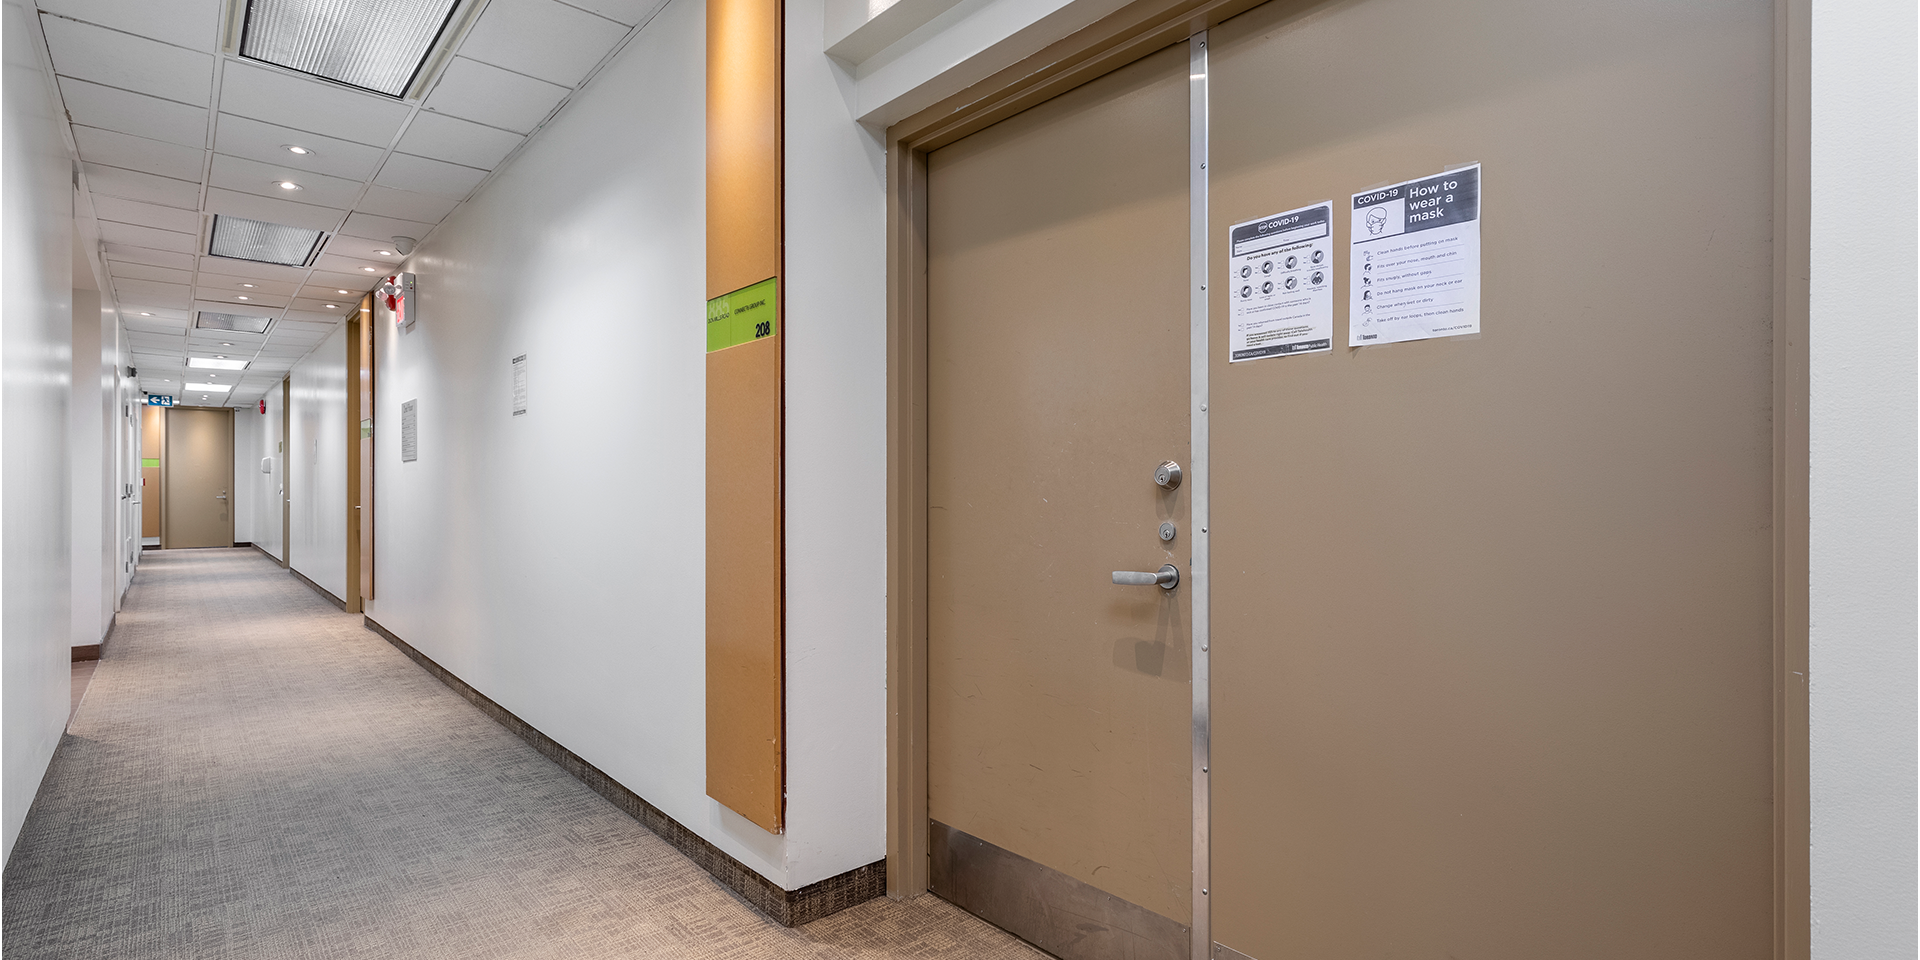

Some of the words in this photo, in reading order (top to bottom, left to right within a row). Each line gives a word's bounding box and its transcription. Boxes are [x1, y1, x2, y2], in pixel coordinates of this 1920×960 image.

[1358, 188, 1398, 205] COVID-19
[1409, 184, 1439, 198] How
[1443, 180, 1458, 191] to
[1410, 196, 1441, 211] wear
[1446, 194, 1453, 203] a
[1269, 215, 1299, 229] COVID-19
[1409, 207, 1444, 223] mask
[755, 320, 770, 338] 208
